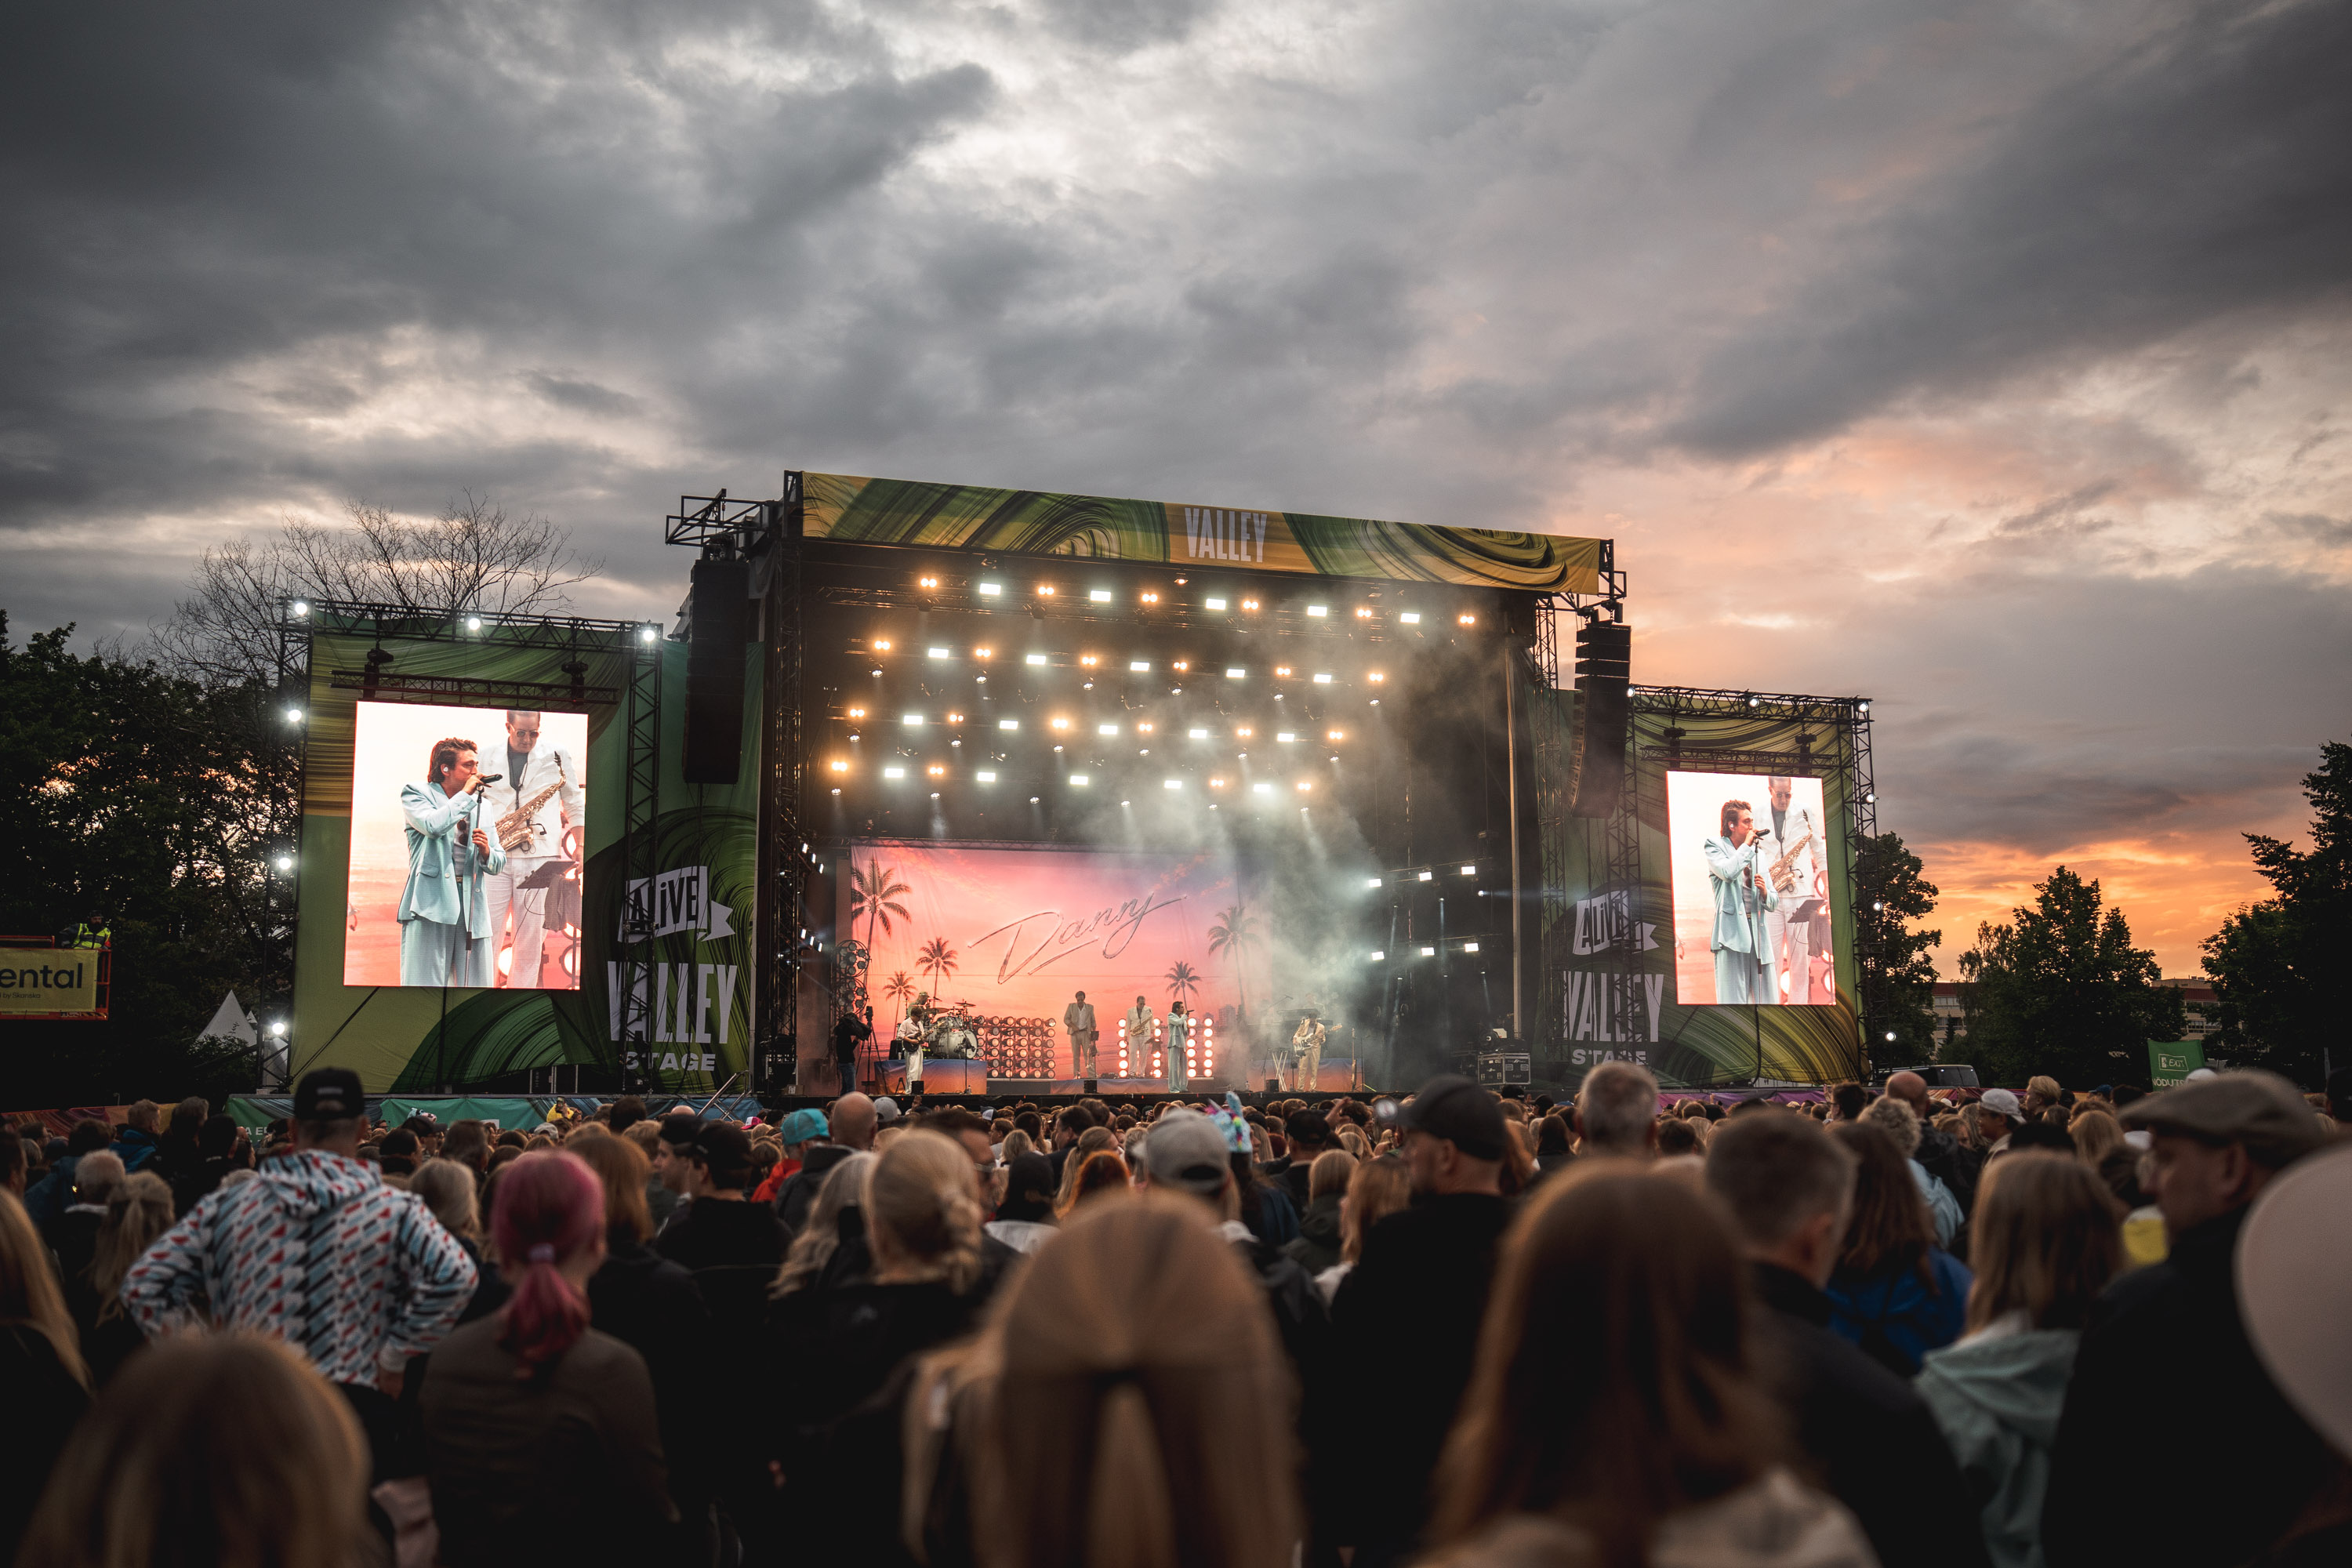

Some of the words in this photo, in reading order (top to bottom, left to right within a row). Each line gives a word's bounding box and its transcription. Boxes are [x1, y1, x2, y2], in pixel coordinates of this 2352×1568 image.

[1185, 507, 1268, 563] VALLEY
[967, 892, 1188, 985] Danny
[607, 960, 739, 1044] VALLEY
[1563, 970, 1664, 1043] VALLEY
[626, 1051, 717, 1072] STAGE
